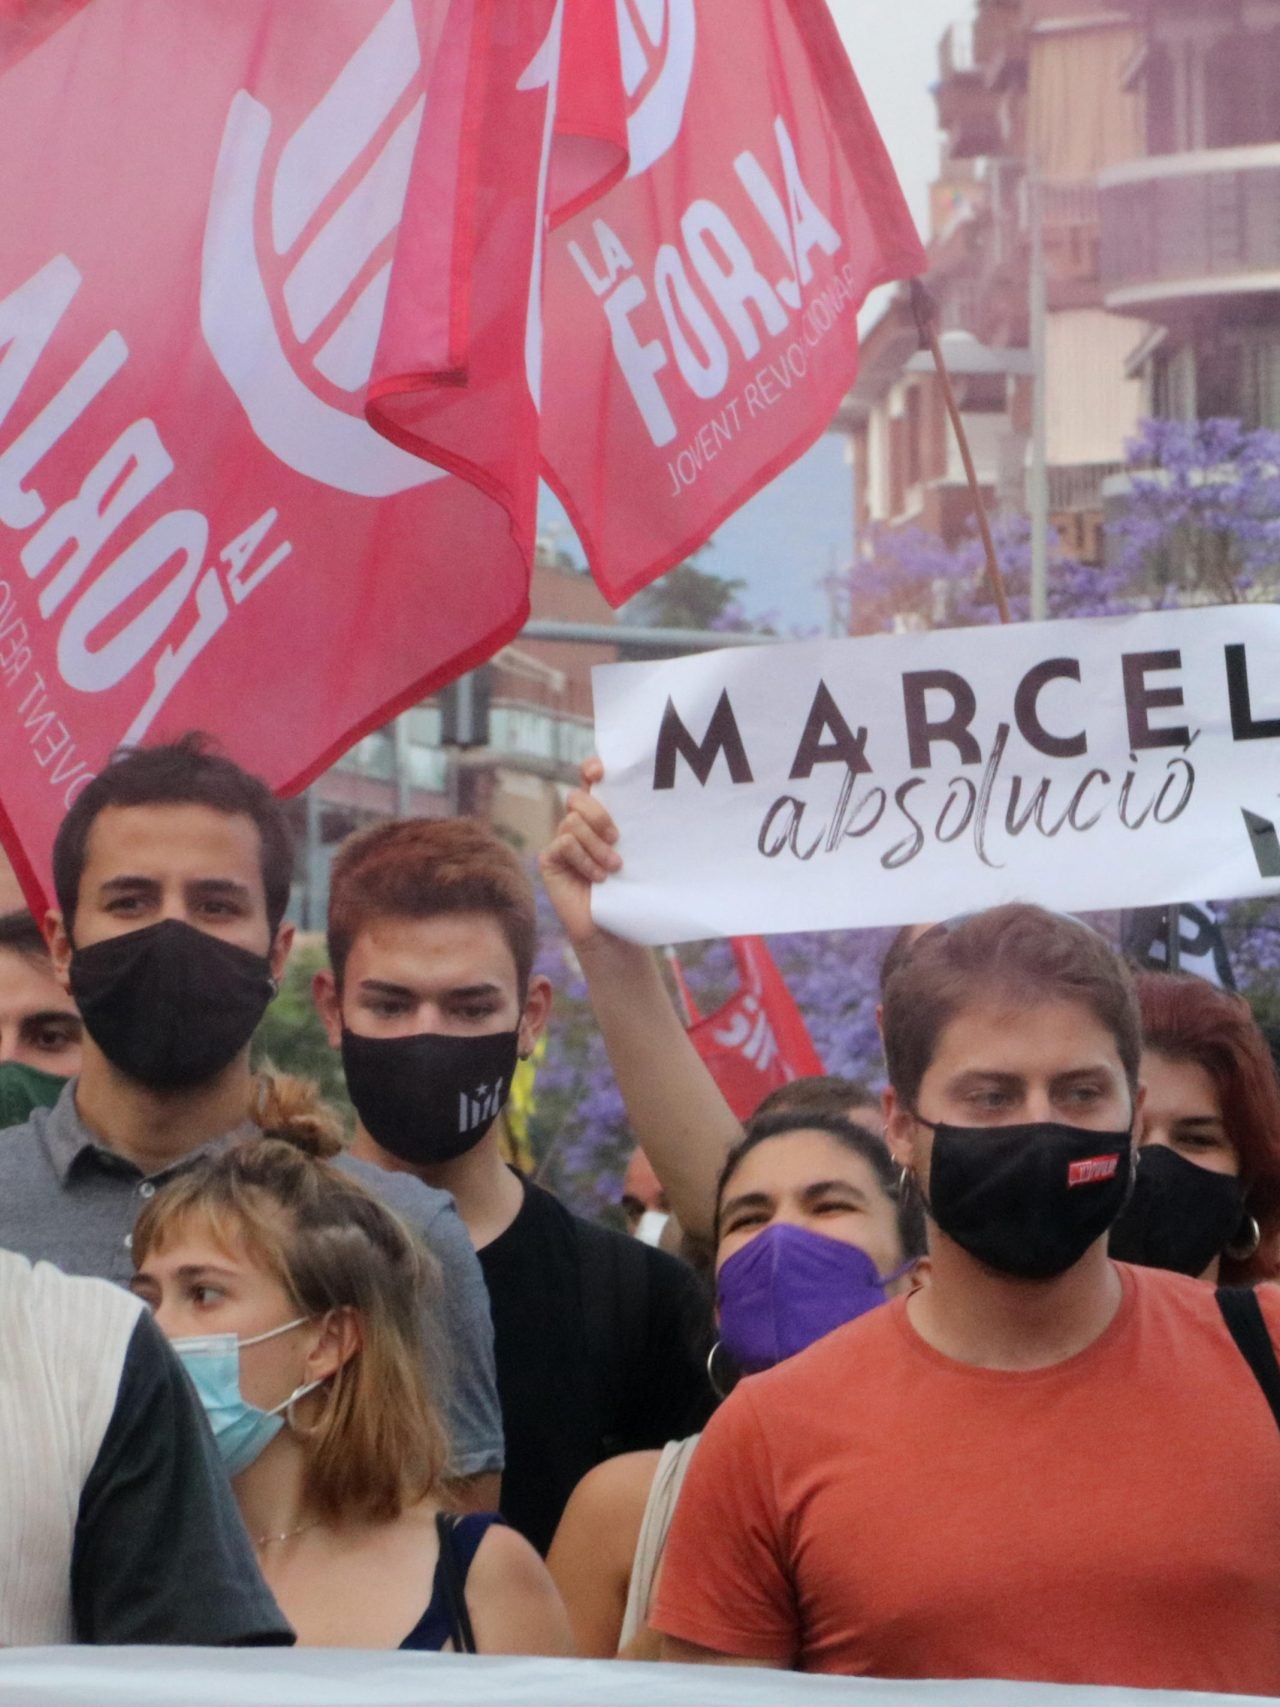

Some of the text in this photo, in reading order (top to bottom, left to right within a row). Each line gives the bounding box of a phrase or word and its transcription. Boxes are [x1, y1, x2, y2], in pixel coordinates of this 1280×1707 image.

[567, 218, 633, 295] LA
[603, 113, 841, 448] FORJA
[666, 399, 742, 496] JOVENT
[758, 723, 1200, 869] absolució
